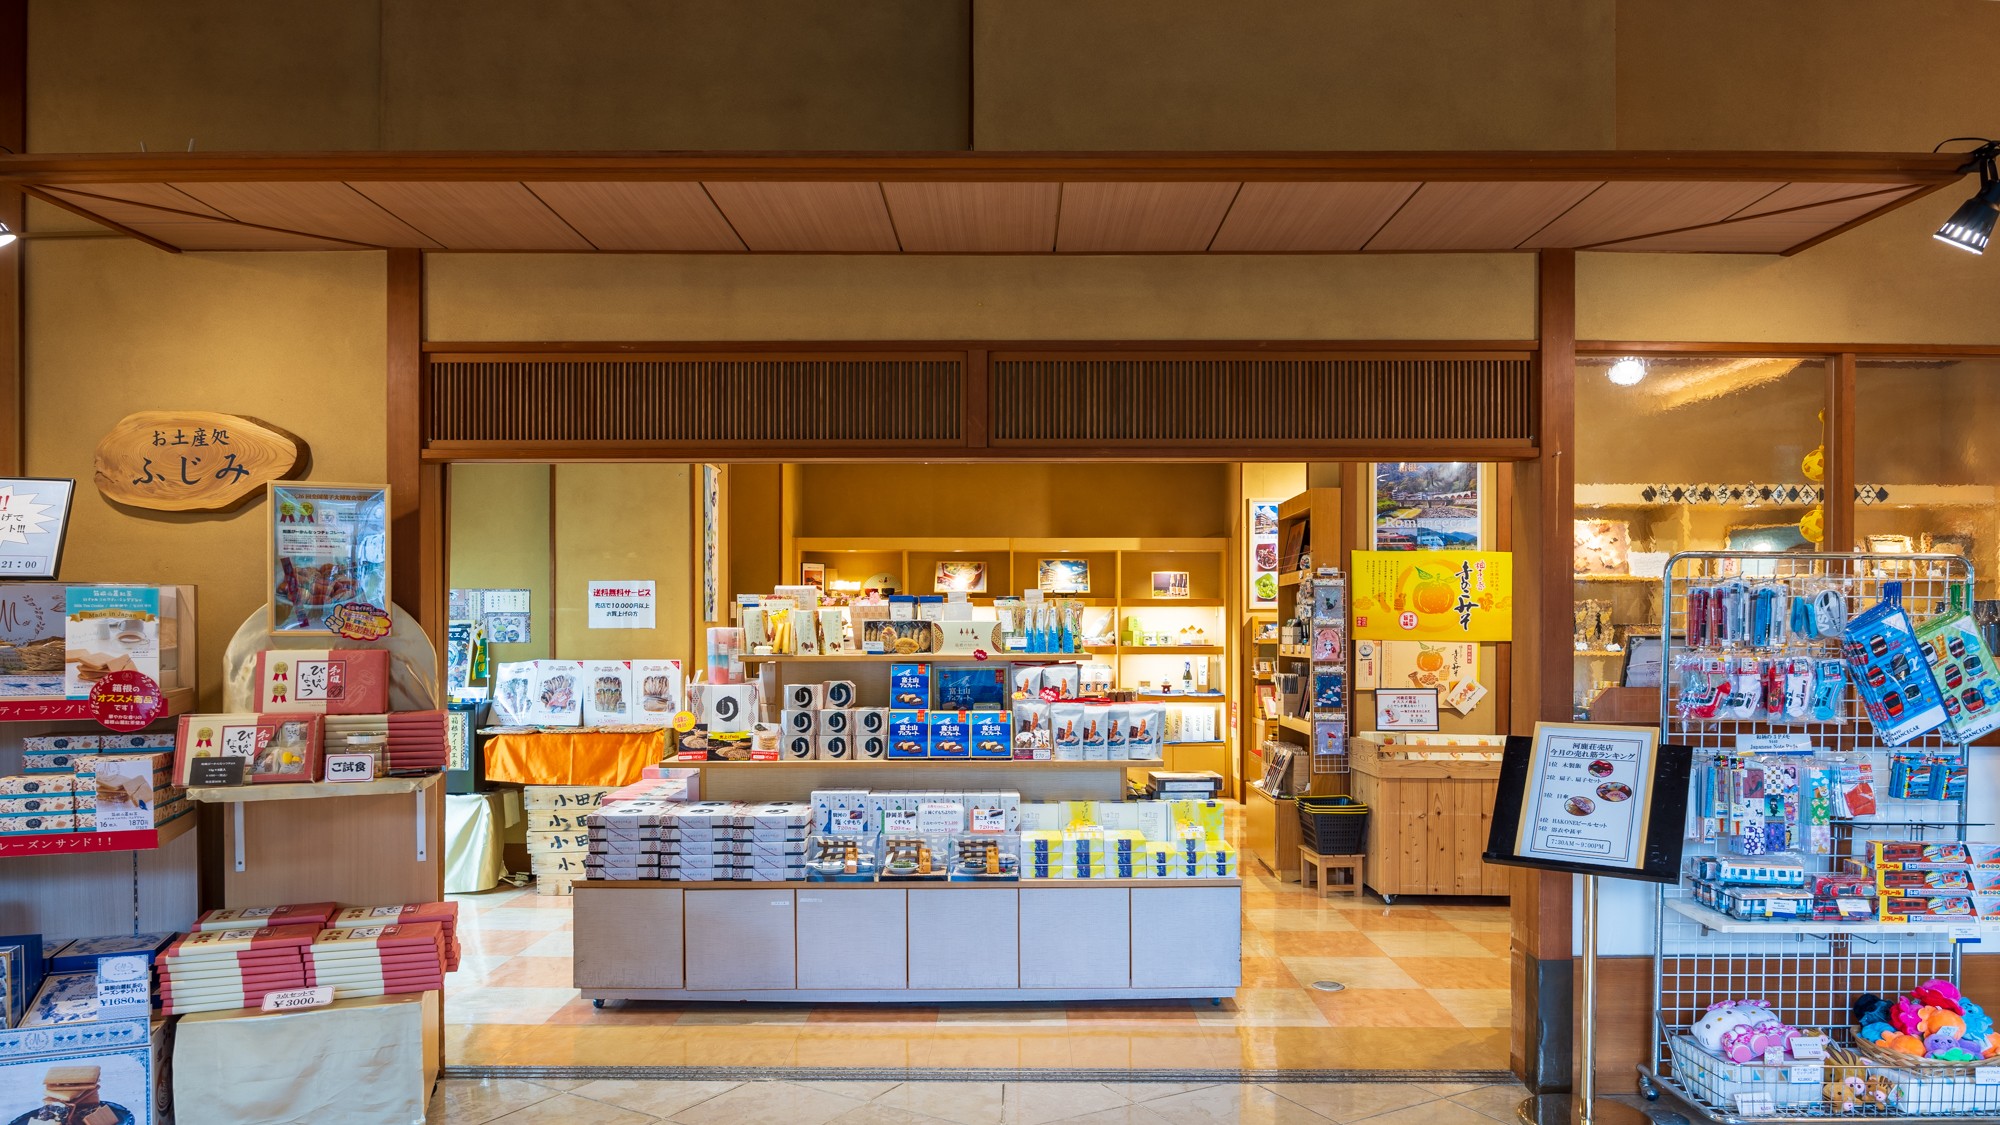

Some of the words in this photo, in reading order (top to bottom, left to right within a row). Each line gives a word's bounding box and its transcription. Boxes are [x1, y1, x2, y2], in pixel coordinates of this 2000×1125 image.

[152, 428, 230, 447] お土産処
[132, 452, 250, 486] ふじみ
[1384, 517, 1468, 528] Romancecar
[112, 684, 140, 692] 箱根の
[98, 694, 153, 703] オススメ商品
[1573, 742, 1614, 751] 河鹿荘売店
[1550, 749, 1636, 760] 今月の売れ筋ランキング
[331, 762, 366, 773] ご試食
[551, 835, 588, 849] 小田
